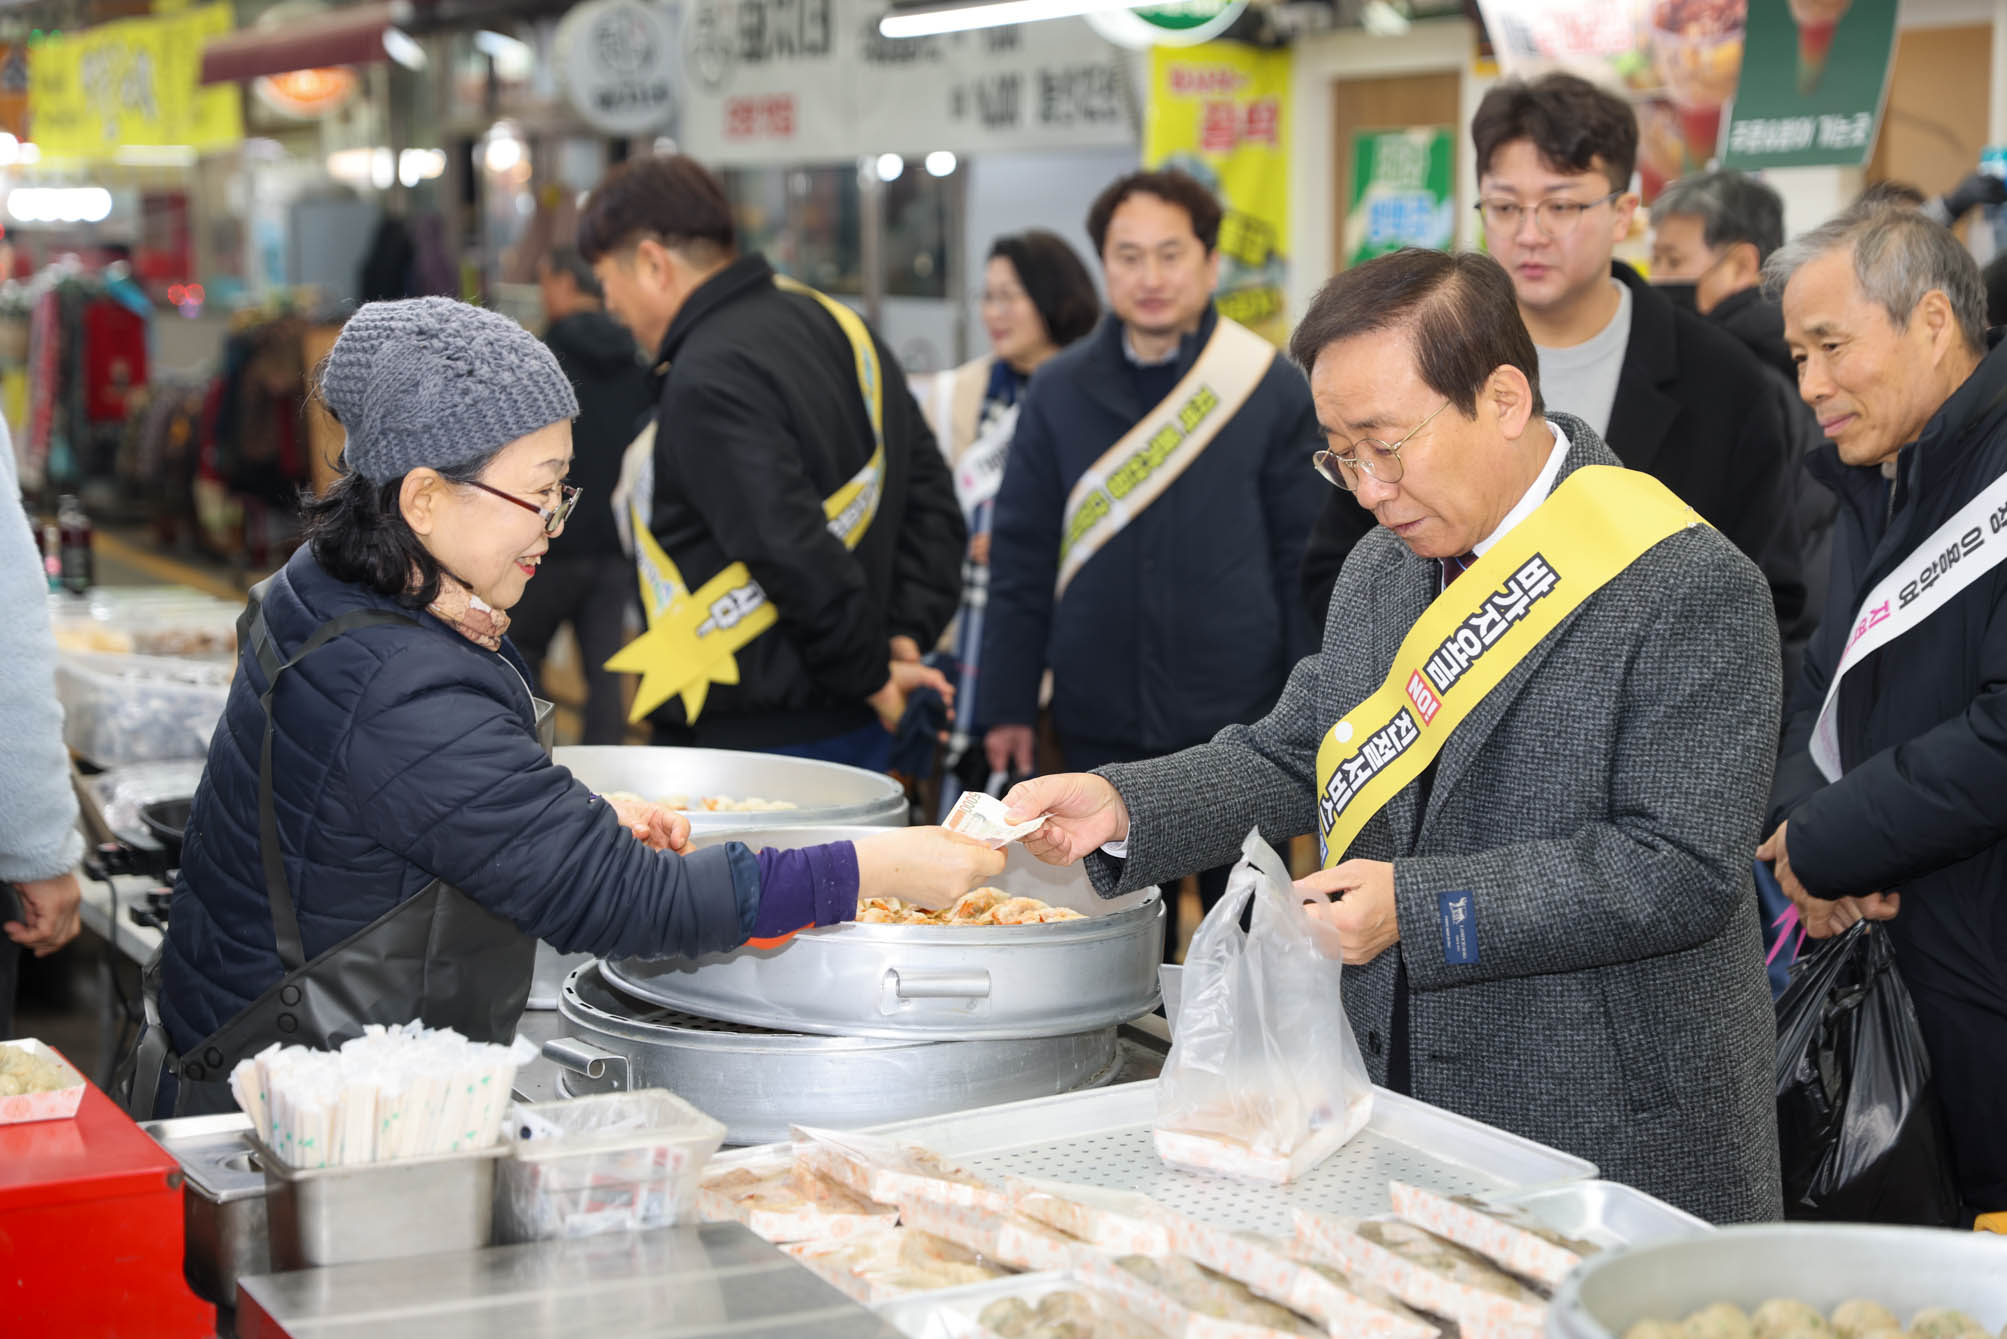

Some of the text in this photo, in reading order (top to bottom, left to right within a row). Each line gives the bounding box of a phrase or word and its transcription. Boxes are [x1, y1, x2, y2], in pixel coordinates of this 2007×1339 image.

[1898, 526, 1985, 610] 이용하여
[1320, 554, 1560, 836] 바가지요금 NO! 친절서비스
